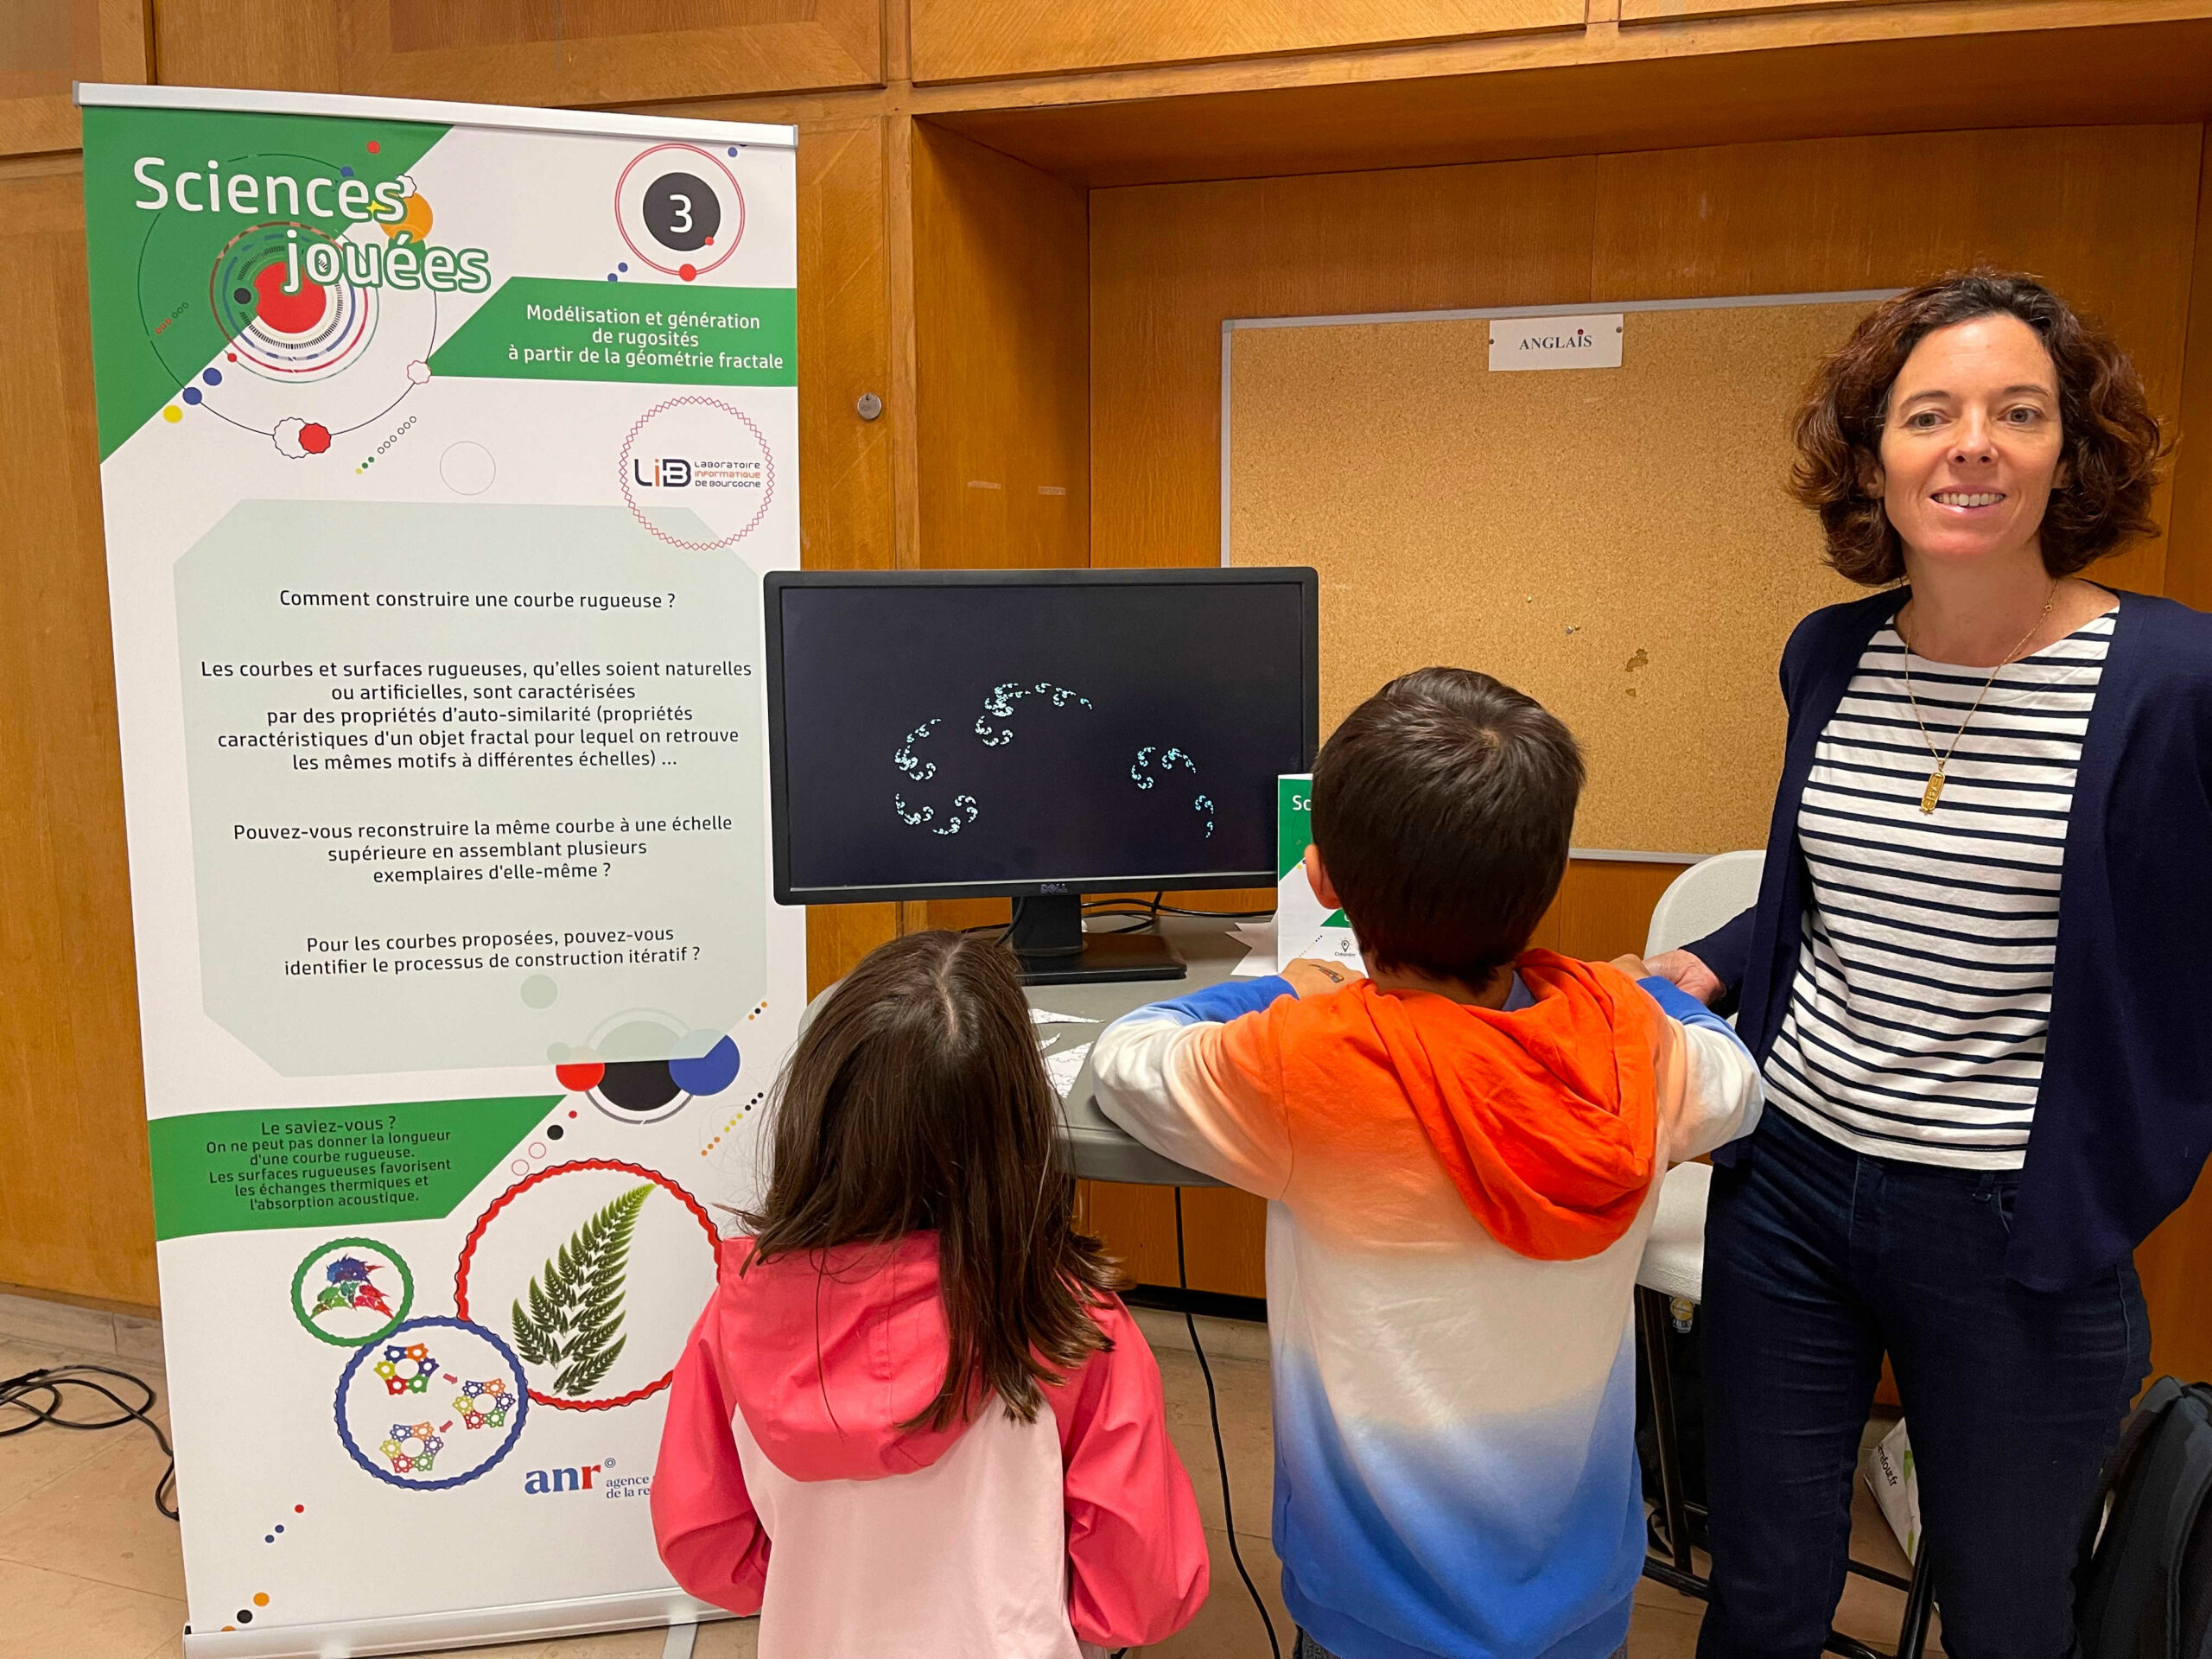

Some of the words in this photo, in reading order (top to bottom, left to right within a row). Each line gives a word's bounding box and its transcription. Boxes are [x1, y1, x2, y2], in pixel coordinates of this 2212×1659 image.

[133, 156, 405, 221] Sciences
[670, 194, 693, 233] 3
[283, 229, 488, 294] jouées
[527, 304, 640, 324] Modélisation
[645, 311, 663, 326] et
[668, 312, 760, 329] génération
[593, 327, 613, 343] de
[619, 331, 699, 348] rugosités
[1519, 334, 1592, 351] ANGLAIS
[509, 345, 518, 359] à
[524, 346, 575, 364] partir
[579, 347, 599, 363] de
[605, 347, 620, 364] la
[626, 351, 714, 367] géométrie
[719, 352, 783, 369] fractale
[280, 590, 370, 606] Comment
[377, 591, 469, 607] construire
[476, 595, 507, 607] une
[514, 592, 574, 607] courbe
[581, 596, 662, 611] rugueuse
[668, 593, 675, 607] ?
[201, 661, 233, 677] Les
[240, 661, 313, 677] courbes
[319, 663, 337, 677] et
[343, 661, 422, 677] surfaces
[429, 664, 526, 679] rugueuses,
[533, 661, 601, 679] qu’elles
[607, 661, 660, 676] soient
[666, 661, 751, 676] naturelles
[332, 689, 353, 700] ou
[360, 683, 467, 701] artificielles,
[474, 685, 512, 699] sont
[518, 683, 635, 699] caractérisées
[267, 712, 297, 727] par
[303, 708, 334, 723] des
[341, 707, 436, 727] propriétés
[442, 706, 590, 721] d’auto-similarité
[597, 705, 692, 724] (propriétés
[218, 731, 368, 750] caractéristiques
[374, 730, 412, 746] d'un
[419, 730, 465, 748] objet
[471, 729, 529, 745] fractal
[534, 733, 575, 747] pour
[581, 728, 634, 747] lequel
[639, 732, 660, 743] on
[666, 729, 738, 742] retrouve
[293, 754, 318, 770] les
[325, 754, 391, 770] mêmes
[398, 753, 456, 768] motifs
[462, 753, 472, 767] à
[478, 752, 573, 767] différentes
[579, 749, 655, 766] échelles)
[234, 824, 352, 840] Pouvez-vous
[359, 821, 468, 838] reconstruire
[475, 820, 490, 835] la
[496, 819, 550, 835] même
[556, 818, 614, 834] courbe
[620, 817, 629, 832] à
[636, 820, 666, 832] une
[672, 816, 732, 831] échelle
[328, 845, 426, 864] supérieure
[433, 847, 453, 859] en
[460, 842, 562, 858] assemblant
[567, 841, 646, 859] plusieurs
[373, 866, 483, 884] exemplaires
[489, 863, 597, 880] d'elle-même
[603, 862, 611, 876] ?
[1040, 883, 1068, 893] DELL
[308, 938, 349, 952] Pour
[355, 936, 380, 950] les
[386, 933, 456, 950] courbes
[462, 930, 558, 950] proposées,
[564, 930, 674, 947] pouvez-vous
[285, 959, 367, 976] identifier
[373, 957, 388, 973] le
[395, 957, 483, 975] processus
[489, 953, 509, 968] de
[516, 950, 623, 967] construction
[629, 946, 687, 963] itératif
[693, 946, 700, 960] ?
[262, 1122, 279, 1135] Le
[285, 1119, 383, 1135] saviez-vous
[390, 1116, 396, 1129] ?
[207, 1141, 226, 1154] On
[231, 1142, 248, 1152] ne
[252, 1139, 284, 1153] peut
[289, 1140, 313, 1152] pas
[318, 1136, 367, 1147] donner
[372, 1133, 384, 1145] la
[389, 1132, 451, 1145] longueur
[251, 1154, 288, 1166] d'une
[293, 1151, 340, 1164] courbe
[345, 1148, 415, 1163] rugueuse.
[210, 1172, 233, 1184] Les
[238, 1168, 298, 1181] surfaces
[302, 1166, 376, 1180] rugueuses
[380, 1159, 451, 1174] favorisent
[235, 1185, 255, 1197] les
[260, 1182, 326, 1196] échanges
[330, 1178, 410, 1192] thermiques
[415, 1175, 429, 1186] et
[251, 1196, 334, 1211] l'absorption
[339, 1192, 418, 1206] acoustique.
[524, 1465, 601, 1495] anr
[606, 1476, 650, 1490] agence
[606, 1487, 621, 1498] de
[624, 1486, 635, 1497] la
